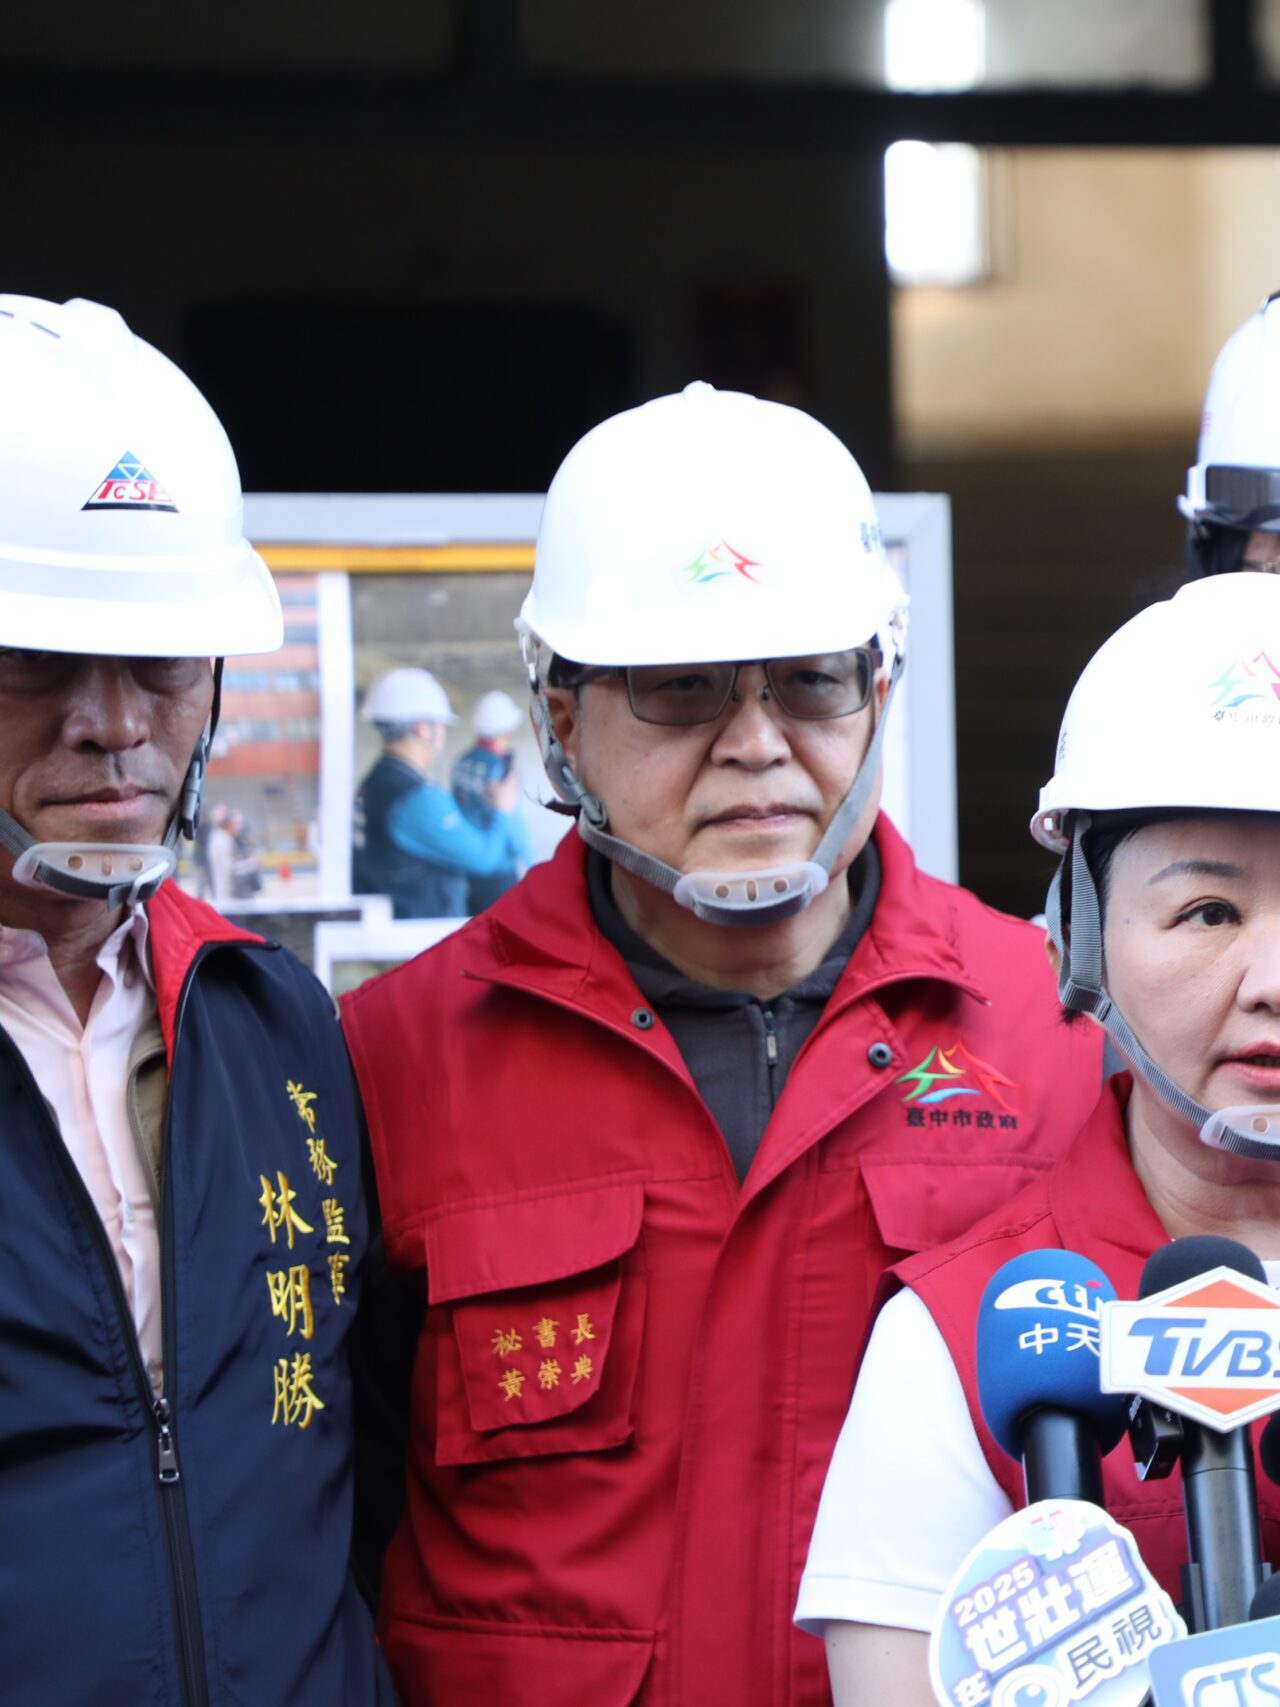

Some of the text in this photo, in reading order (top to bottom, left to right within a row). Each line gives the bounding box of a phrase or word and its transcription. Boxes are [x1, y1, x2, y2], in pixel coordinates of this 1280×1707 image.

[906, 1107, 1019, 1130] 臺中市政府
[259, 1170, 325, 1430] 林明勝
[1018, 1322, 1101, 1357] 中天
[953, 1560, 1035, 1628] 2025
[965, 1539, 1134, 1672] 世壯運
[1067, 1604, 1163, 1689] 民視
